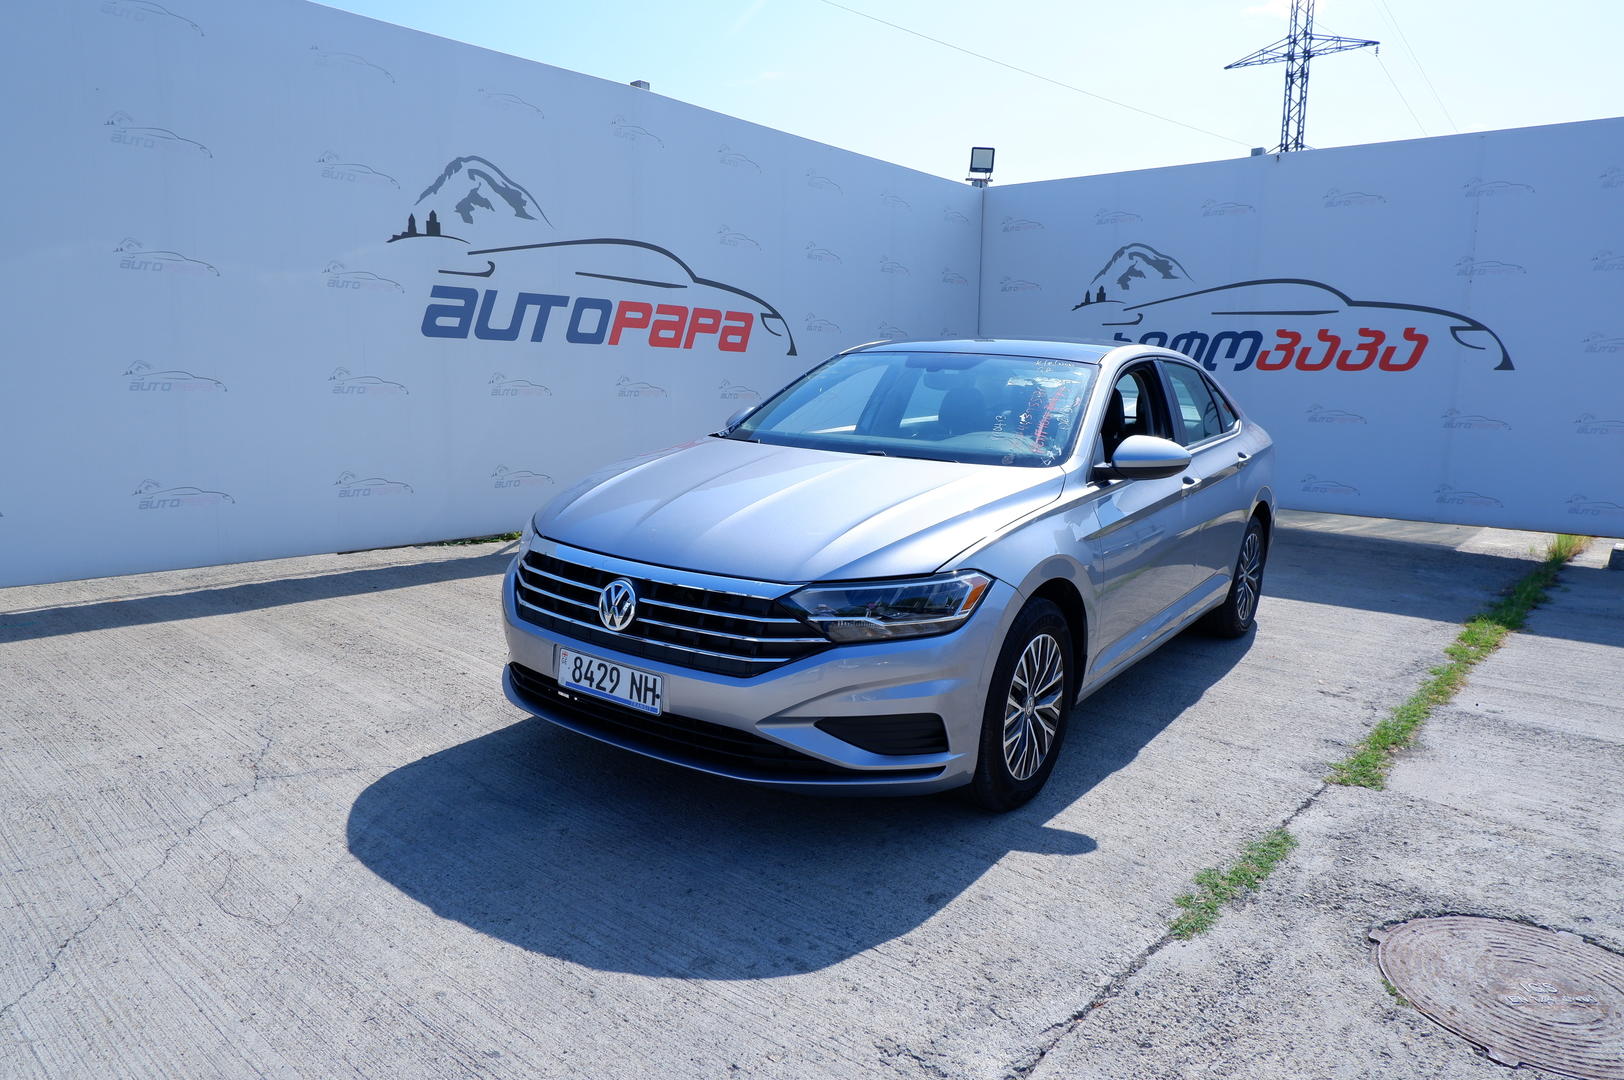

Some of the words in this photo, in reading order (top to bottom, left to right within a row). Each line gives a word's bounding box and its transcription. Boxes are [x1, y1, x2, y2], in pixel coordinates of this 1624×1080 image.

[1113, 327, 1429, 372] ტოპაპა
[571, 656, 621, 694] 8429
[629, 671, 657, 706] NH
